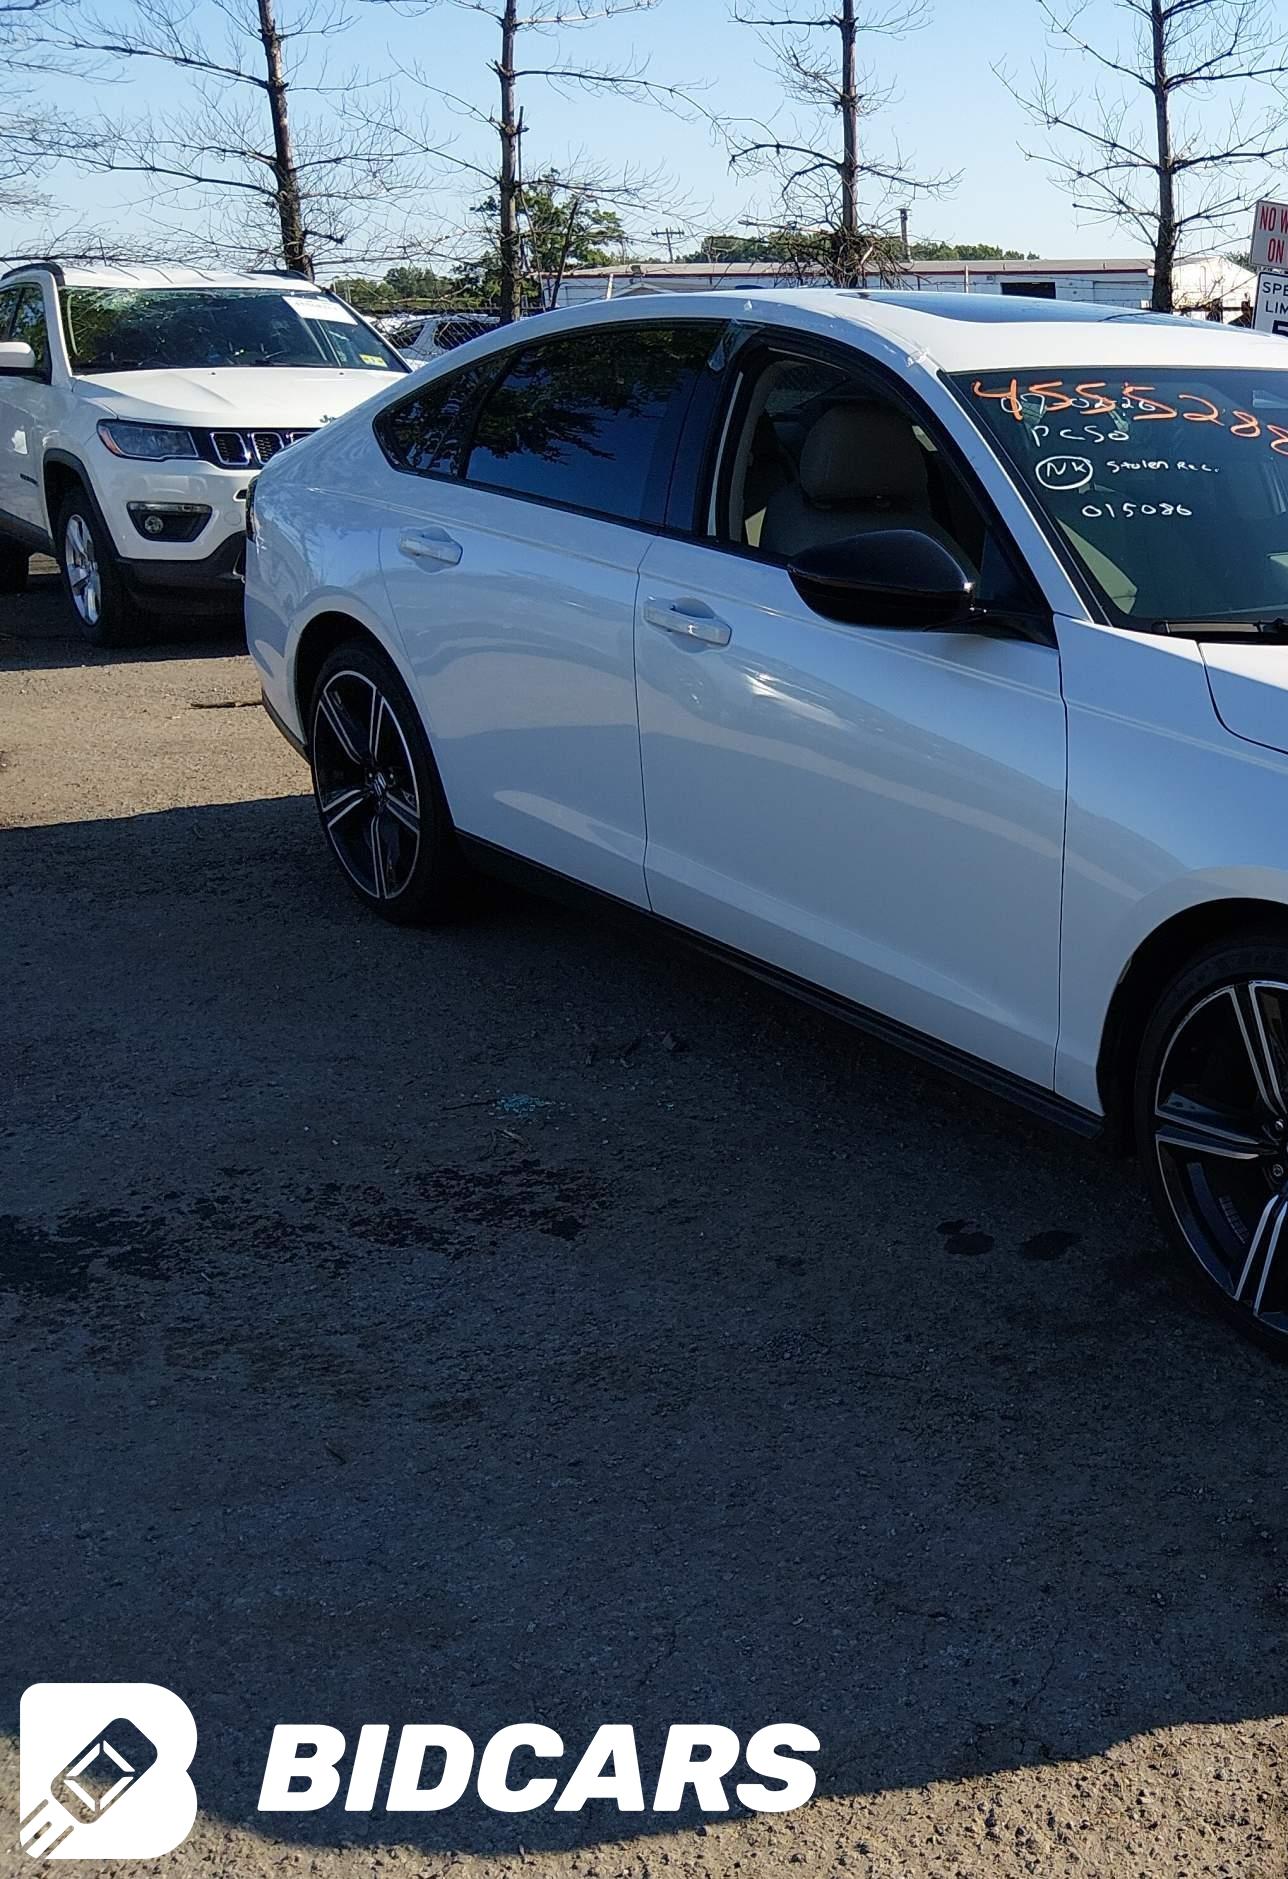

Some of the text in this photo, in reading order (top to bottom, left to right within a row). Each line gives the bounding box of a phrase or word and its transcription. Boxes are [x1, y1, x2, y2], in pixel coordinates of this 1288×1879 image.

[1259, 205, 1277, 231] NO
[1268, 238, 1285, 264] ON
[1106, 459, 1169, 474] Stolen
[1081, 502, 1193, 518] 015086
